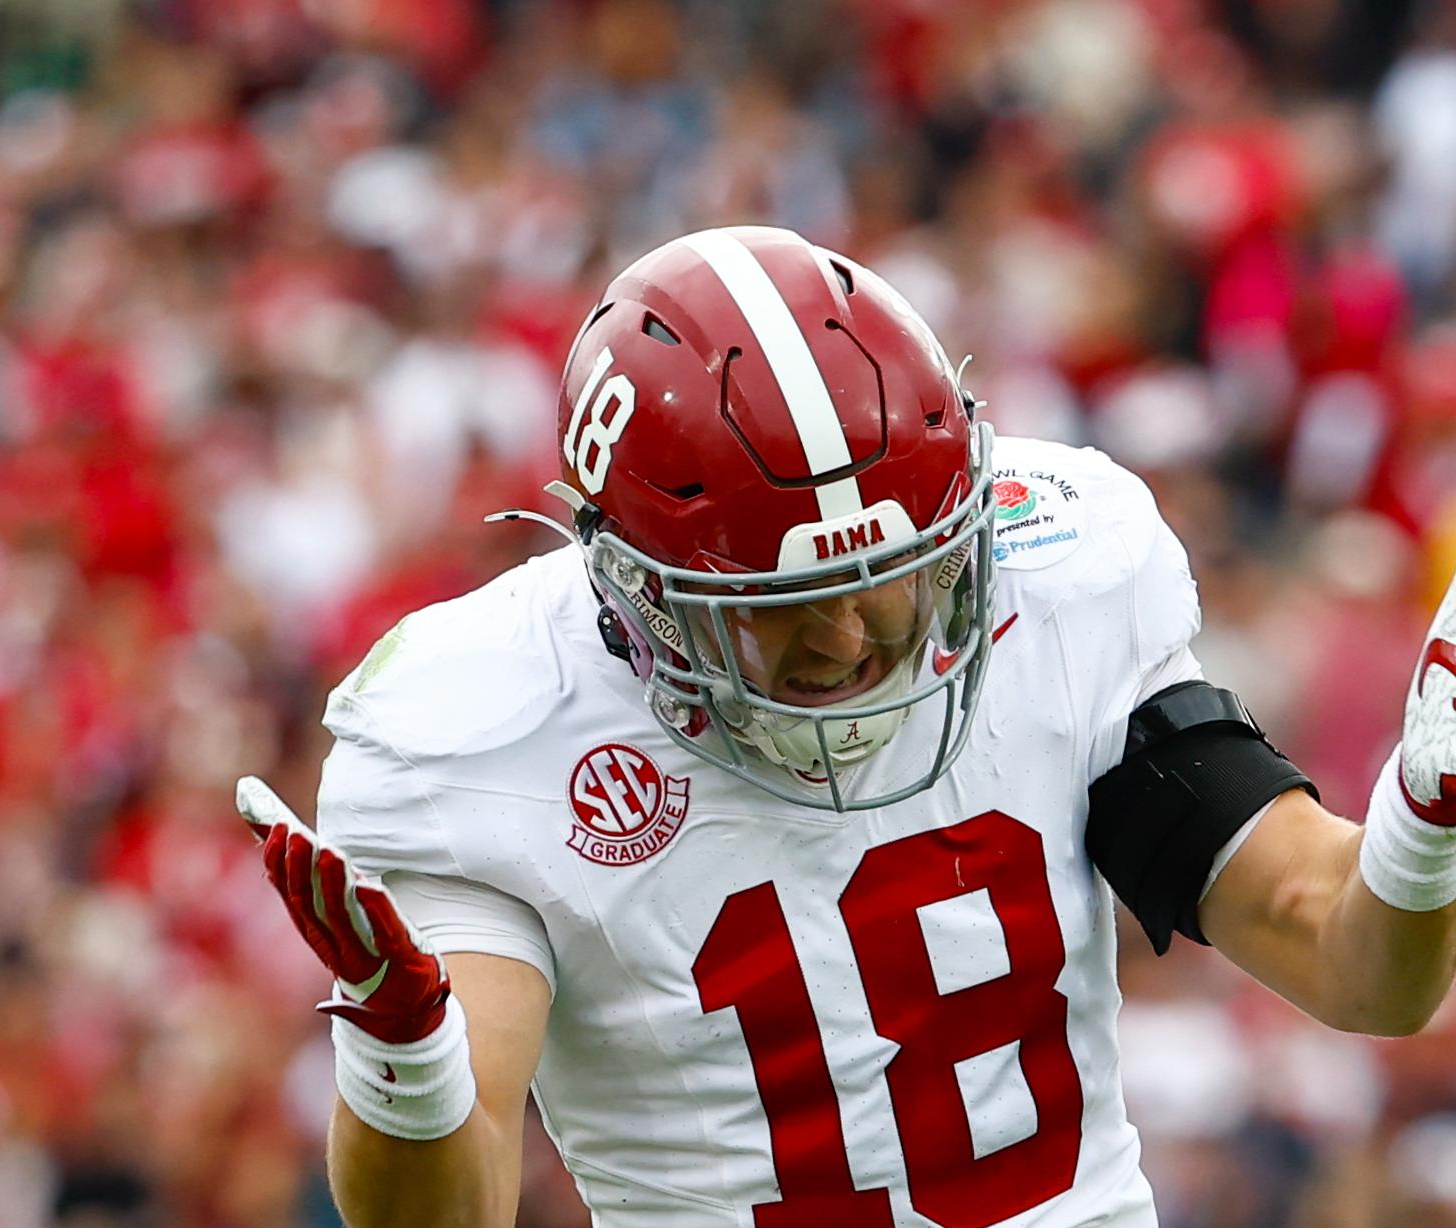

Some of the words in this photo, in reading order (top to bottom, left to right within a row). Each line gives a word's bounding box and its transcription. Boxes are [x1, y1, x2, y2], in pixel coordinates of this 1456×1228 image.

[563, 345, 636, 495] 18
[1029, 470, 1079, 502] GAME
[812, 518, 886, 560] BAMA
[996, 516, 1040, 537] presented
[1042, 514, 1055, 524] by
[1009, 528, 1079, 553] Prudential
[630, 592, 683, 648] RIMSON
[574, 748, 658, 833] SEC
[591, 803, 683, 862] GRADUATE
